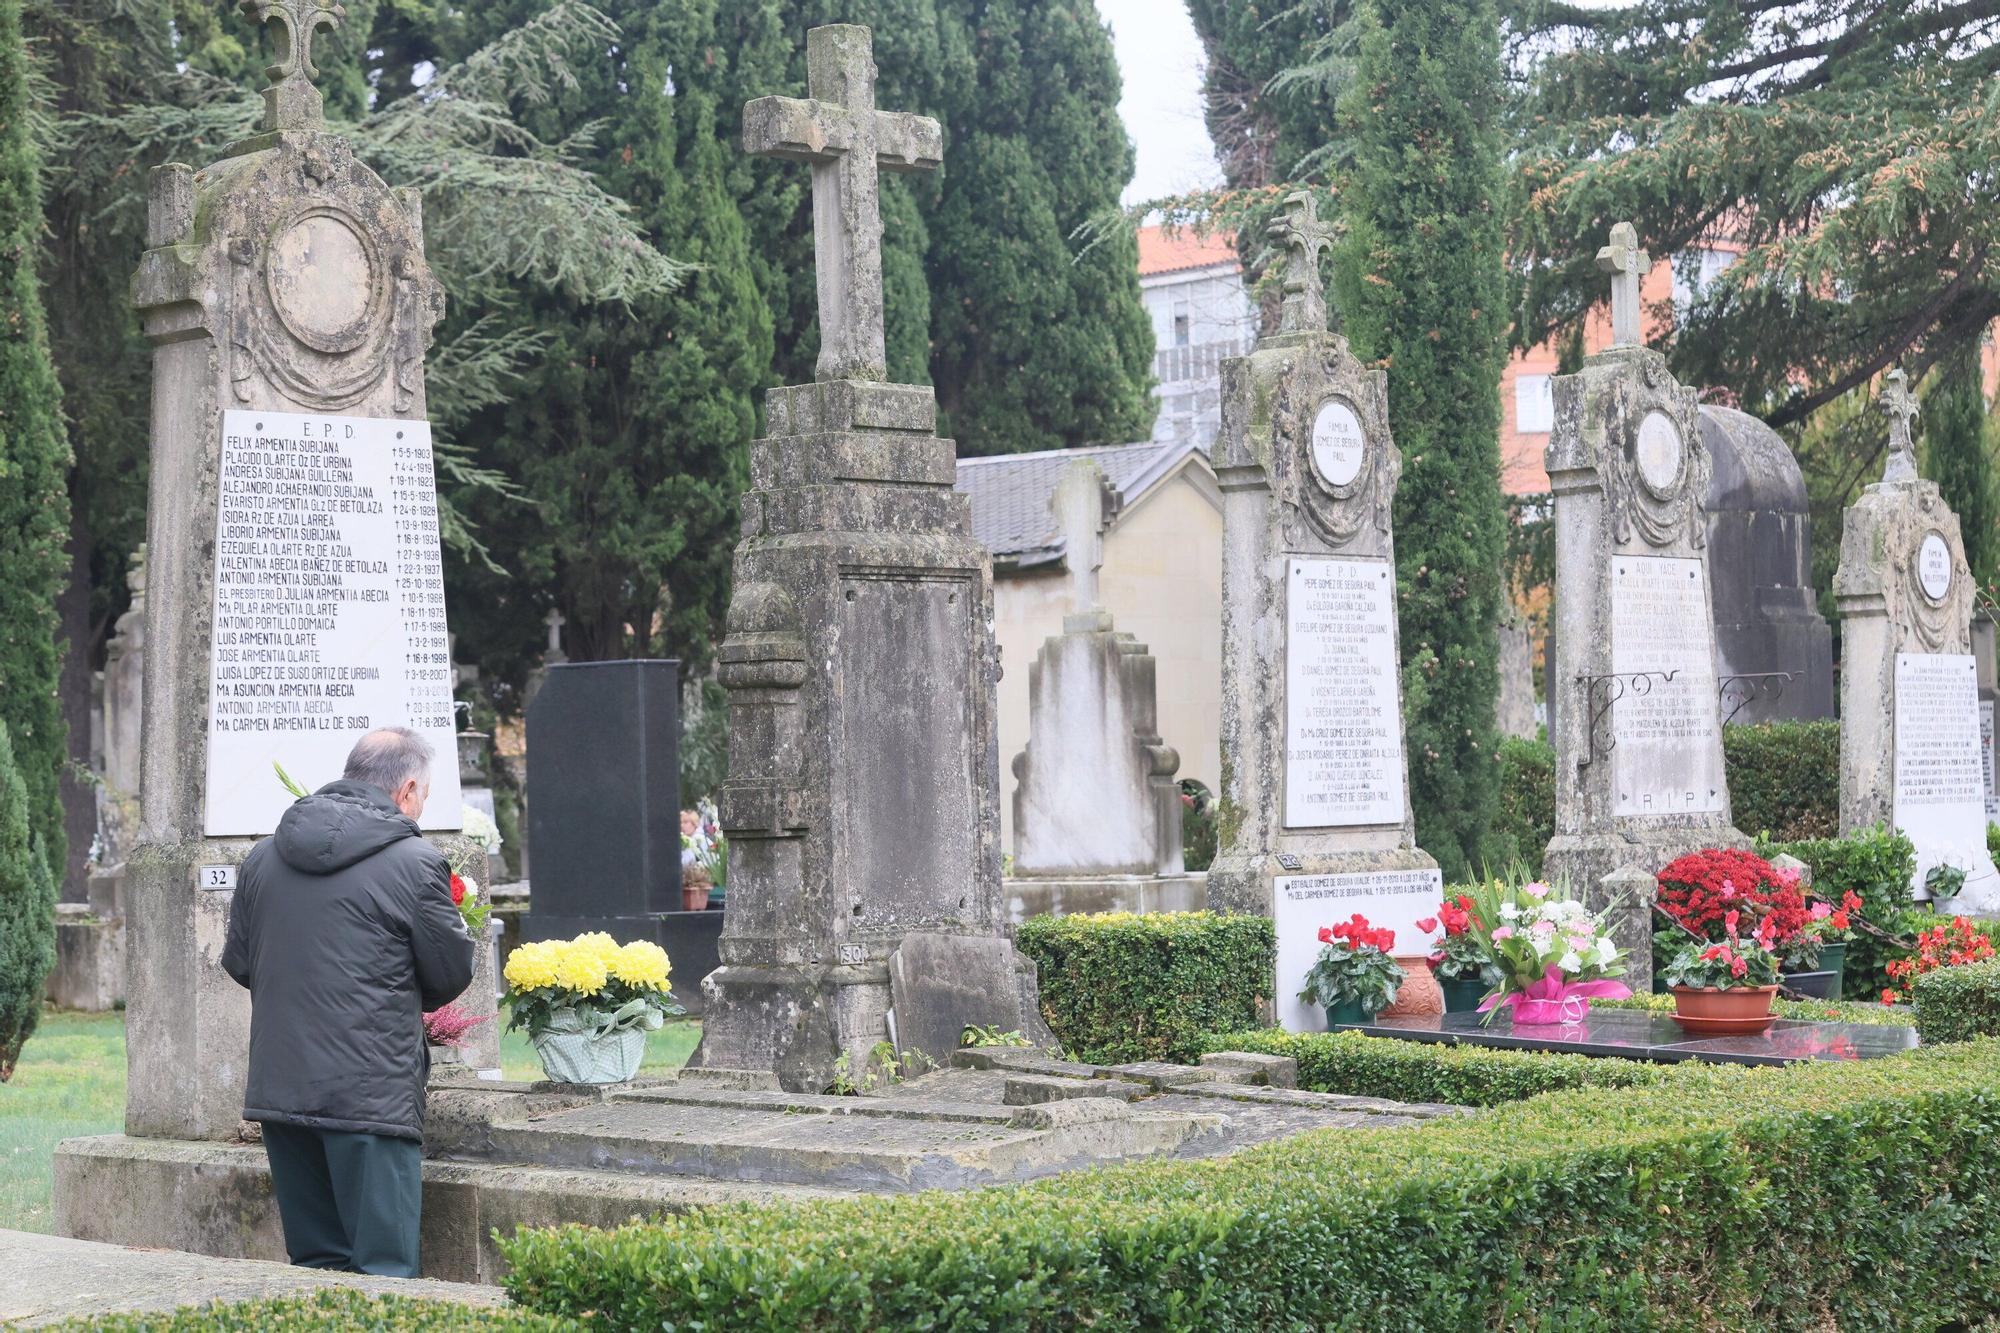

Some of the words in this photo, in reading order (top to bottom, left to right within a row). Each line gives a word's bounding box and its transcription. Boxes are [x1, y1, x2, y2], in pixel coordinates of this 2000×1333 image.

[227, 436, 252, 450] FELIX
[255, 437, 297, 451] ARMENTIA
[299, 440, 339, 454] SUBIJANA
[398, 447, 431, 459] 5-5-1903
[225, 450, 262, 466] PLACIDO
[263, 452, 296, 467] OLARTE
[310, 455, 321, 468] DE
[323, 456, 352, 469] URBINA
[401, 462, 432, 474] 4-4-1919
[224, 465, 263, 479] ANDRESA
[265, 466, 306, 481] SUBIJANA
[308, 469, 353, 483] GUILLERNA
[396, 475, 433, 487] 19-11-1923
[223, 480, 273, 495] ALEJANDRO
[275, 482, 332, 497] ACHAERANDIO
[333, 485, 373, 499] SUBIJANA
[400, 490, 434, 502] 15-5-1927
[223, 494, 264, 509] EVARISTO
[266, 497, 309, 511] ARMENTIA
[327, 499, 338, 512] DE
[340, 500, 383, 514] BETOLAZA
[399, 504, 436, 516] 24-6-1928
[222, 510, 249, 524] ISIDRA
[264, 511, 275, 525] DE
[277, 512, 299, 526] AZUA
[301, 513, 334, 527] LARREA
[221, 525, 254, 539] LIBORIO
[256, 526, 299, 540] ARMENTIA
[300, 528, 341, 542] SUBIJANA
[404, 533, 438, 545] 16-8-1934
[221, 540, 268, 555] EZEQUIELA
[270, 542, 303, 556] OLARTE
[317, 544, 328, 558] DE
[330, 544, 352, 558] AZUA
[221, 556, 267, 570] VALENTINA
[269, 557, 299, 571] ABECIA
[300, 554, 330, 572] IBAÑEZ
[332, 559, 343, 573] DE
[345, 560, 388, 574] BETOLAZA
[404, 563, 440, 575] 22-3-1937
[219, 571, 255, 585] ANTONIO
[258, 572, 300, 585] ARMENTIA
[302, 573, 343, 586] SUBIJANA
[401, 578, 441, 589] 25-10-1962
[1305, 579, 1317, 589] PEPE
[1319, 579, 1336, 589] GOMEZ
[1345, 580, 1363, 590] SEGURA
[1364, 580, 1376, 590] PAUL
[219, 588, 229, 599] EL
[230, 588, 275, 600] PRESBITERO
[316, 588, 358, 601] ARMENTIA
[361, 589, 389, 602] ABECIA
[233, 601, 258, 615] PILAR
[260, 602, 303, 615] ARMENTIA
[305, 603, 338, 616] OLARTE
[407, 607, 444, 618] 18-11-1975
[1313, 601, 1333, 611] EULOGIA
[1355, 602, 1376, 612] CALZADA
[218, 616, 253, 629] ANTONIO
[255, 616, 296, 630] PORTILLO
[298, 617, 335, 630] DOMAICA
[1300, 623, 1317, 633] FELIPE
[1319, 623, 1336, 633] GOMEZ
[1345, 624, 1363, 634] SEGURA
[217, 632, 237, 645] LUIS
[239, 632, 282, 646] ARMENTIA
[284, 633, 316, 646] OLARTE
[415, 637, 446, 648] 3-2-1991
[217, 648, 239, 662] JOSE
[241, 649, 286, 663] ARMENTIA
[287, 649, 320, 663] OLARTE
[1332, 645, 1347, 654] JUANA
[217, 666, 242, 680] LUISA
[244, 666, 272, 680] LOPEZ
[274, 666, 286, 680] DE
[287, 666, 310, 680] SUSO
[311, 666, 336, 680] ORTIZ
[337, 666, 349, 680] DE
[350, 667, 380, 680] URBINA
[411, 669, 447, 680] 3-12-2007
[1307, 665, 1323, 676] DANIEL
[1326, 665, 1342, 676] GOMEZ
[1351, 666, 1369, 676] SEGURA
[1371, 666, 1382, 676] PAUL
[233, 683, 275, 697] ASUNCION
[278, 683, 322, 697] ARMENTIA
[325, 684, 355, 697] ABECIA
[1316, 687, 1336, 696] VICENTE
[217, 701, 253, 715] ANTONIO
[257, 700, 300, 714] ARMENTIA
[304, 700, 334, 714] ABECIA
[1313, 707, 1331, 717] TERESA
[1353, 707, 1382, 717] BARTOLOME
[233, 717, 269, 732] CARMEN
[273, 717, 316, 730] ARMENTIA
[333, 716, 344, 730] DE
[347, 715, 369, 729] SUSO
[418, 716, 451, 728] 7-6-2024
[1316, 728, 1328, 738] CRUZ
[1330, 728, 1347, 738] GOMEZ
[1356, 728, 1374, 738] SEGURA
[1375, 728, 1387, 738] PAUL
[1296, 750, 1312, 761] JUSTA
[1314, 750, 1334, 760] ROSARIO
[1336, 750, 1352, 760] PEREZ
[1307, 793, 1328, 804] ANTONIO
[1330, 793, 1347, 803] GOMEZ
[1357, 792, 1376, 802] SEGURA
[210, 870, 227, 885] 32
[1291, 879, 1313, 889] ESTIBALIZ
[1314, 878, 1329, 888] GOMEZ
[1337, 877, 1353, 887] SEGURA
[1420, 871, 1430, 881] AÑOS
[1305, 890, 1322, 899] CARMEN
[1324, 889, 1338, 898] GOMEZ
[1346, 888, 1362, 896] SEGURA
[1363, 887, 1373, 895] PAUL
[1423, 882, 1433, 892] AÑOS
